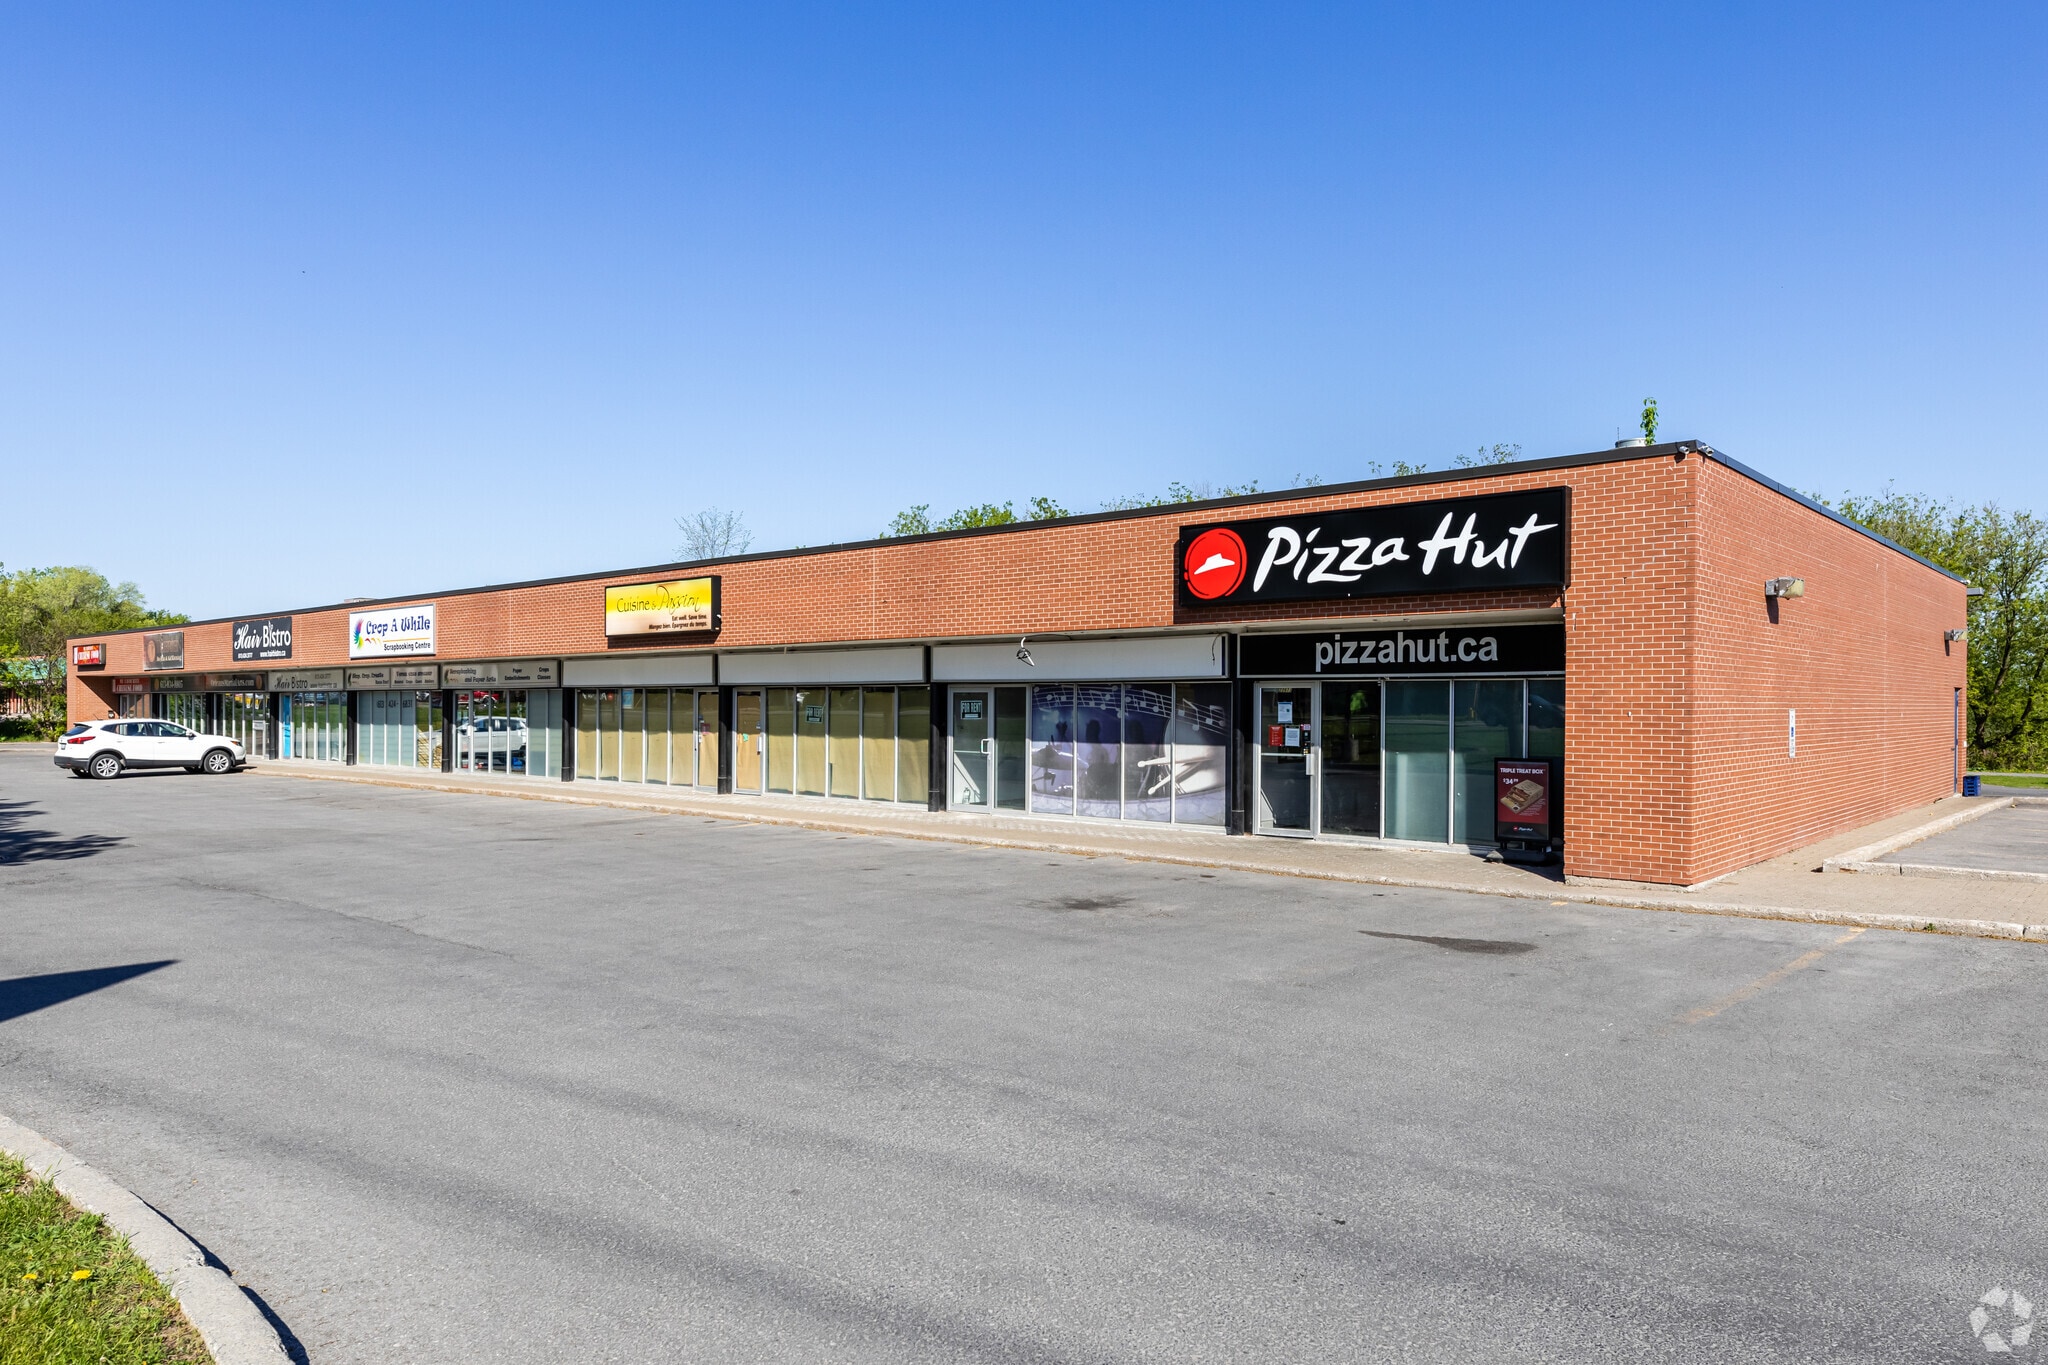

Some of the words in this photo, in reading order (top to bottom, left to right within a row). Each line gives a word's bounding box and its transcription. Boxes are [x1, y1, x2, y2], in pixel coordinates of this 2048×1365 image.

[1253, 525, 1409, 592] Pizza
[1418, 511, 1559, 576] Hut
[617, 596, 650, 612] Cuisine
[656, 585, 700, 615] Passion
[234, 624, 262, 649] Hair
[263, 621, 291, 648] Bistro
[366, 621, 388, 637] Crop
[391, 618, 398, 632] A
[401, 615, 430, 632] While
[384, 643, 414, 652] Scrapbooking
[415, 641, 431, 649] Centre
[1316, 631, 1498, 672] pizzahut.ca
[274, 675, 290, 689] Hair
[291, 676, 308, 689] Bstro
[962, 702, 970, 712] FOR
[971, 702, 981, 712] RENT
